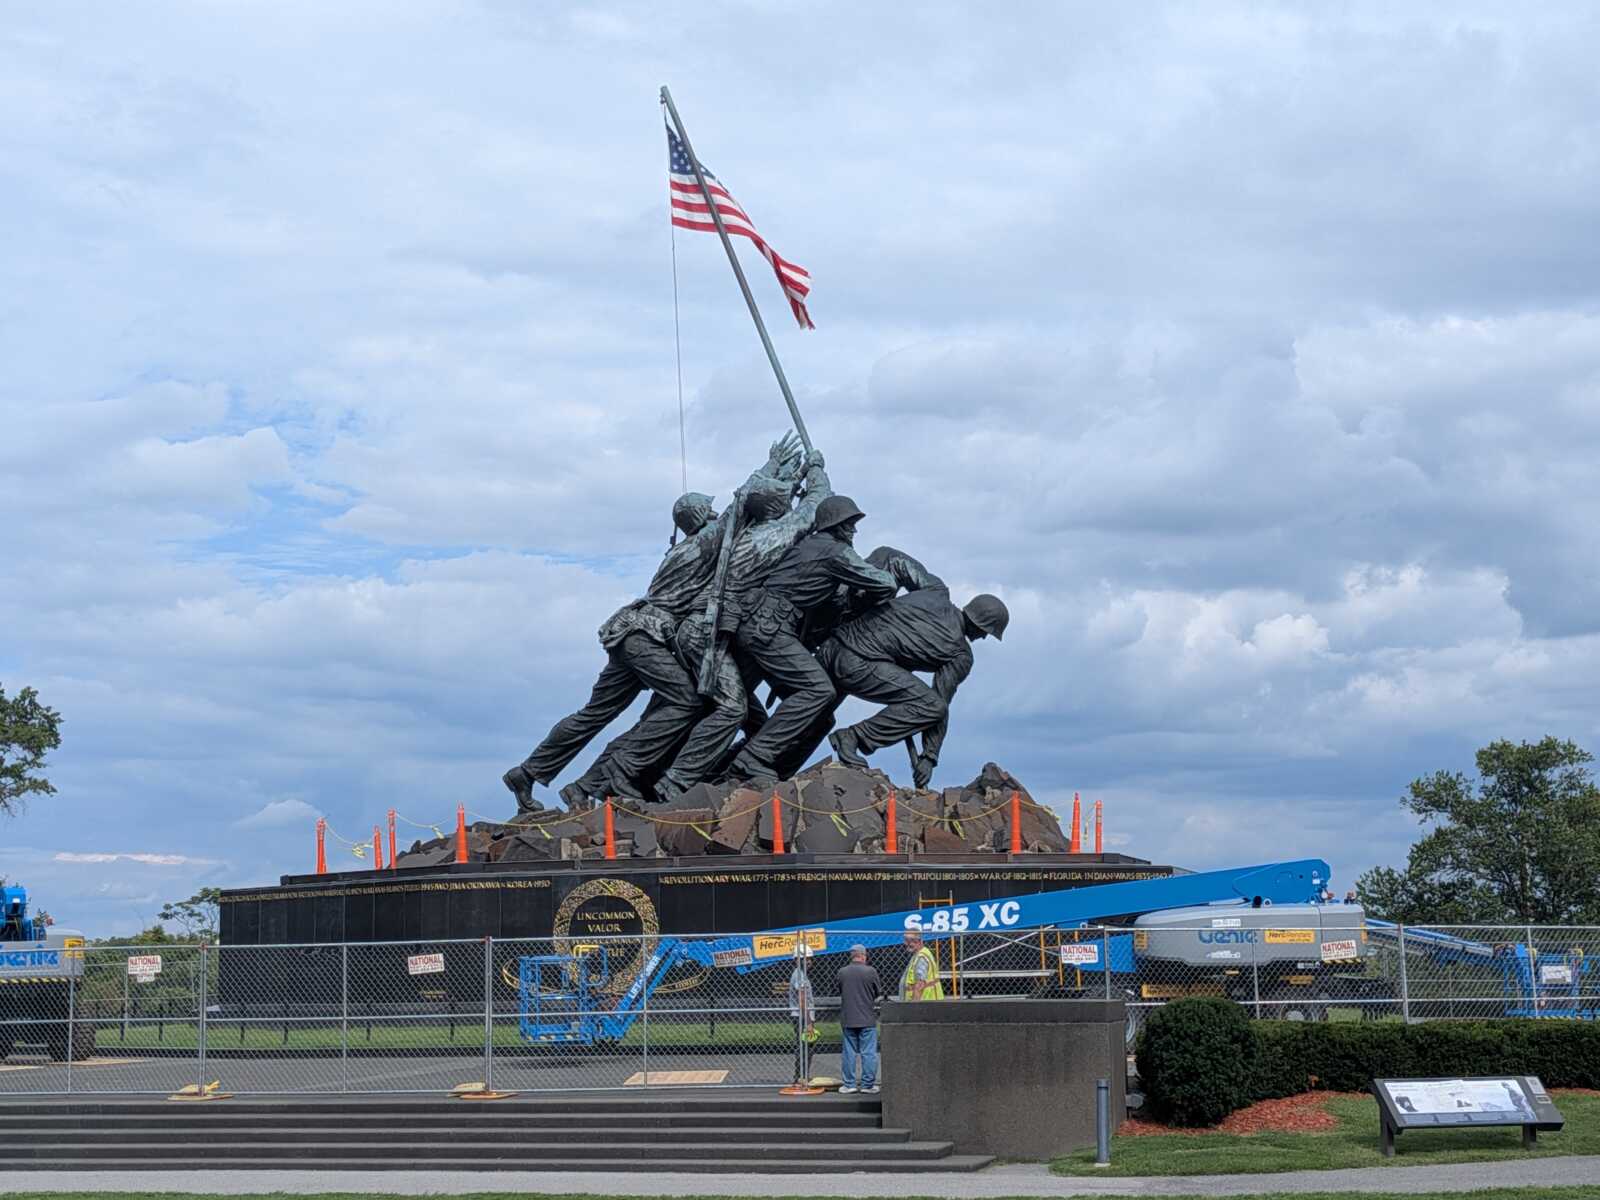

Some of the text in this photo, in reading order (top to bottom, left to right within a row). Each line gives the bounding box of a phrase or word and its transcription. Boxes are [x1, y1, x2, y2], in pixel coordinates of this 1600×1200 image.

[731, 873, 752, 882] WAR
[797, 872, 827, 881] FRENCH
[829, 872, 854, 881] NAVAL
[855, 872, 873, 881] WAR
[979, 872, 1001, 881] WAR
[1049, 872, 1082, 880] FLORIDA
[1084, 872, 1113, 880] INDIAN
[466, 881, 500, 889] OKINAWA
[506, 880, 533, 889] KOREA
[577, 911, 635, 920] UNCOMMON
[903, 901, 1020, 933] S-85 XC
[587, 923, 622, 933] VALOR
[1062, 944, 1096, 955] NATIONAL
[1322, 941, 1355, 952] NATIONAL
[714, 949, 750, 961] NATIONAL
[129, 956, 160, 966] NATIONAL
[409, 955, 443, 966] NATIONAL
